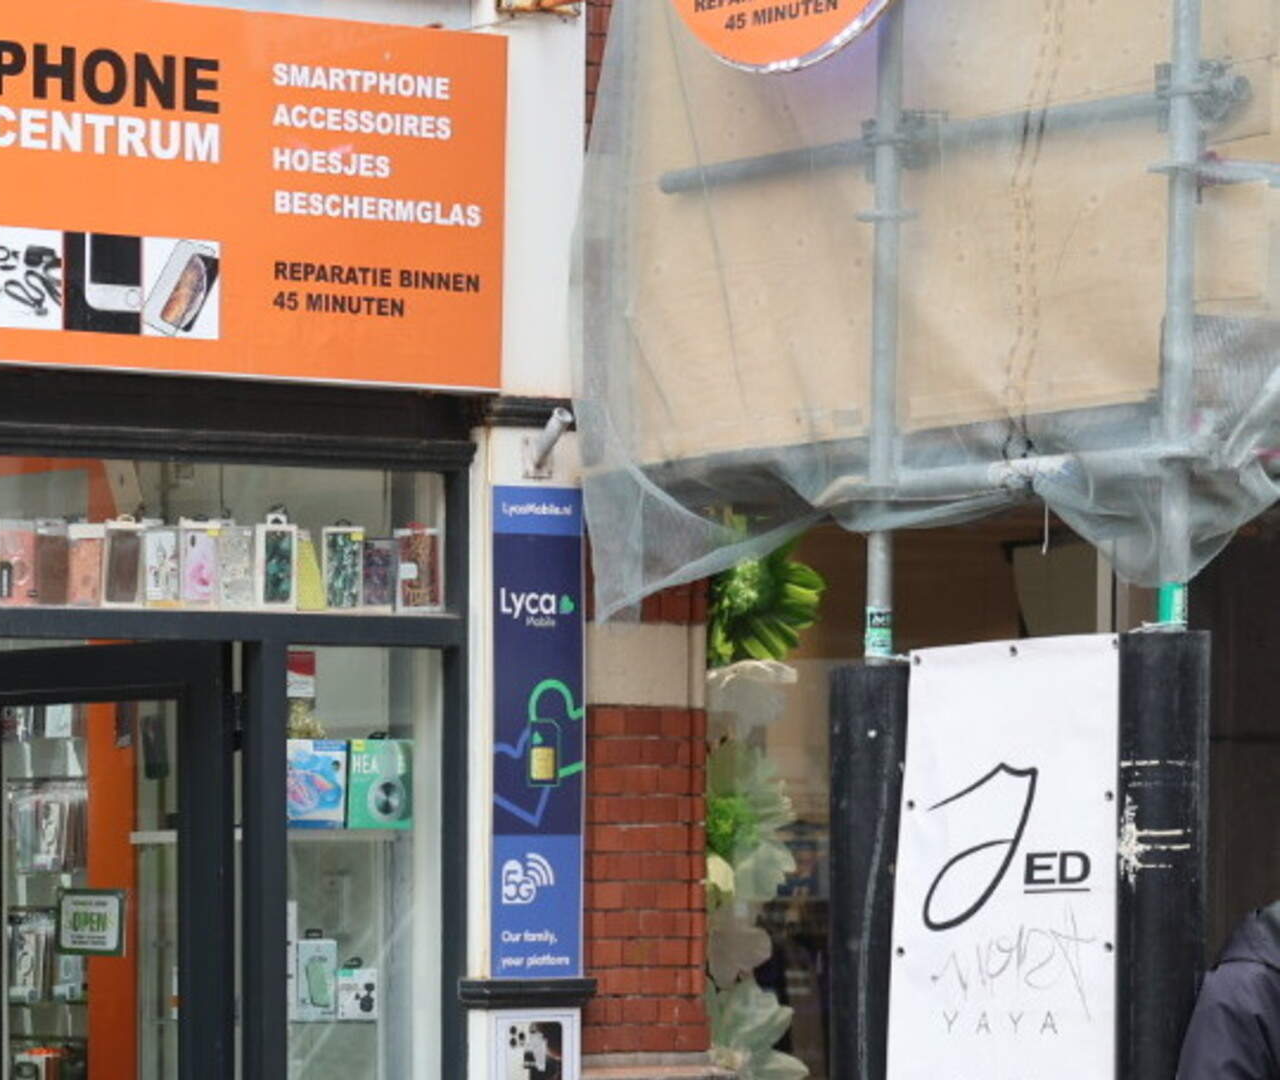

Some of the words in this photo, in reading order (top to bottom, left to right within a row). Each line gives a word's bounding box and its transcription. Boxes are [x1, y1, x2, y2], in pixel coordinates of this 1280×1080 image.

[725, 12, 746, 30] 45
[752, 0, 839, 26] MINUTEN
[273, 63, 450, 100] SMARTPHONE
[273, 104, 452, 140] ACCESSOIRES
[273, 147, 391, 178] HOESJES
[274, 190, 482, 227] BESCHERMGLAS
[274, 261, 392, 287] REPARATIE
[399, 270, 480, 293] BINNEN
[273, 291, 299, 312] 45
[306, 293, 404, 318] MINUTEN
[499, 587, 557, 619] Lyca
[525, 617, 557, 629] Mobile
[502, 859, 536, 904] 5G
[501, 930, 522, 942] Our
[501, 955, 524, 969] your
[943, 1010, 1059, 1035] YAYA
